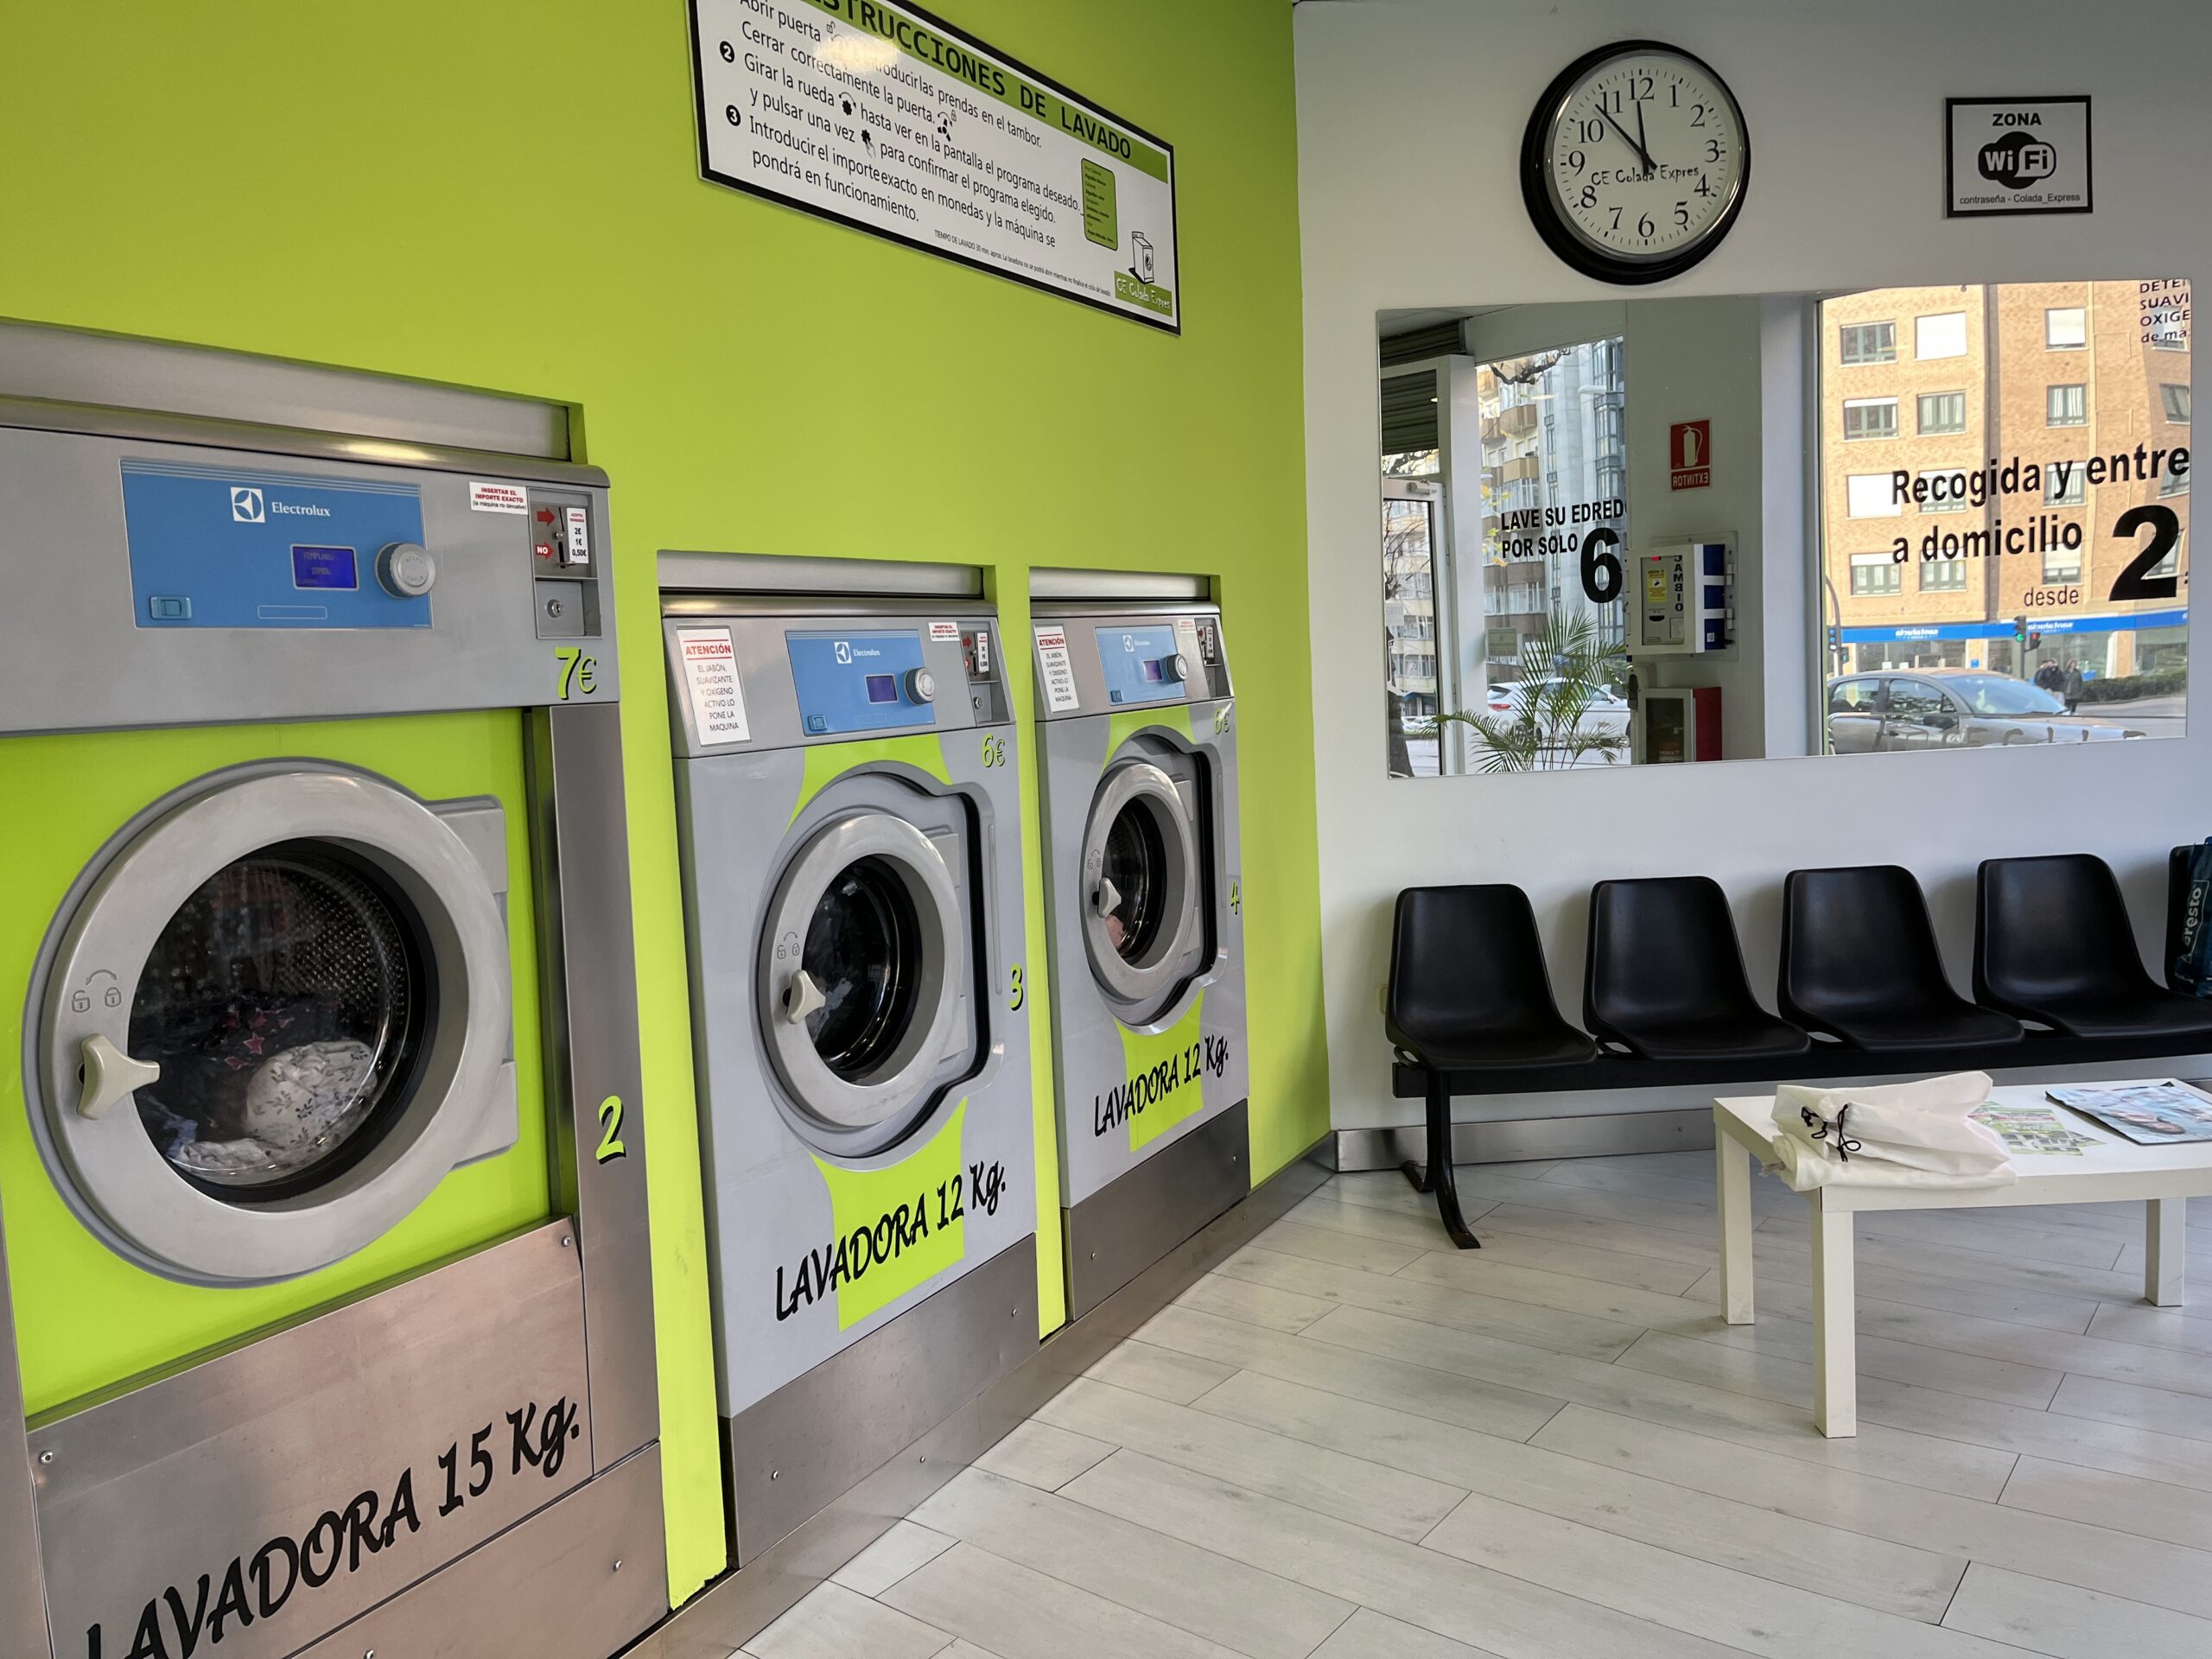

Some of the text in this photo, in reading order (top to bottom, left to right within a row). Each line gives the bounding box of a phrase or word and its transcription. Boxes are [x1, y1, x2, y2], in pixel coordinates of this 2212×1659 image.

[742, 21, 936, 124] Cerrar correctamente la puerta.
[778, 10, 822, 41] puerta
[938, 89, 978, 119] prendas
[982, 111, 994, 126] en
[996, 115, 1005, 131] el
[1007, 122, 1042, 149] tambor.
[1627, 77, 1656, 101] 12
[1669, 85, 1680, 108] 1
[1600, 90, 1624, 114] 11
[1020, 85, 1046, 118] DE
[1061, 106, 1131, 159] LAVADO
[1690, 104, 1706, 129] 2
[1992, 112, 2042, 127] ZONA
[744, 53, 1081, 212] Girar la rueda hasta ver en la pantalla el programa deseado.
[1578, 118, 1605, 144] 10
[749, 87, 1057, 224] y pulsar una vez para confirmar el programa elegido.
[1567, 150, 1586, 177] 9
[1704, 139, 1720, 163] 3
[1984, 149, 2049, 172] WiFi
[749, 115, 1056, 247] Introducir el importe exacto en monedas y la máquina se
[753, 149, 920, 222] pondrá en funcionamiento.
[1591, 164, 1700, 186] CE Colada Expres
[1694, 173, 1711, 198] 4
[1580, 185, 1598, 209] 8
[1960, 193, 2081, 205] contraseña Colada_Express
[1608, 207, 1624, 231] 7
[1637, 211, 1656, 238] 6
[1674, 200, 1689, 226] 5
[2139, 292, 2190, 311] SUAVI
[2139, 309, 2191, 327] OXIGE
[2141, 332, 2159, 343] de
[1891, 442, 2191, 508] Recogida y entre
[271, 501, 332, 517] Electrolux
[1501, 499, 1627, 531] LAVE SU EDRED
[1502, 532, 1578, 559] POR SOLO
[1892, 513, 2083, 564] a domicilio
[1580, 526, 1623, 604] 6
[2024, 585, 2080, 607] desde
[685, 643, 732, 656] ATENCIÓN
[1039, 638, 1065, 647] ATENCIÓN
[554, 646, 598, 701] 7€
[696, 675, 734, 685] SUAVIZANTE
[697, 664, 706, 673] EL
[704, 698, 735, 709] ACTIVO LO
[709, 710, 735, 720] PONE LA
[709, 721, 740, 732] MAQUINA
[981, 733, 1006, 769] 6€
[1230, 881, 1240, 916] 4
[1007, 963, 1023, 1012] 3
[1094, 1034, 1230, 1138] LAVADORA 12 Kg.
[595, 1095, 627, 1166] 2
[775, 1160, 1007, 1322] LAVADORA 12 Kg.
[438, 1421, 493, 1517] 15
[505, 1396, 581, 1478] Kg.
